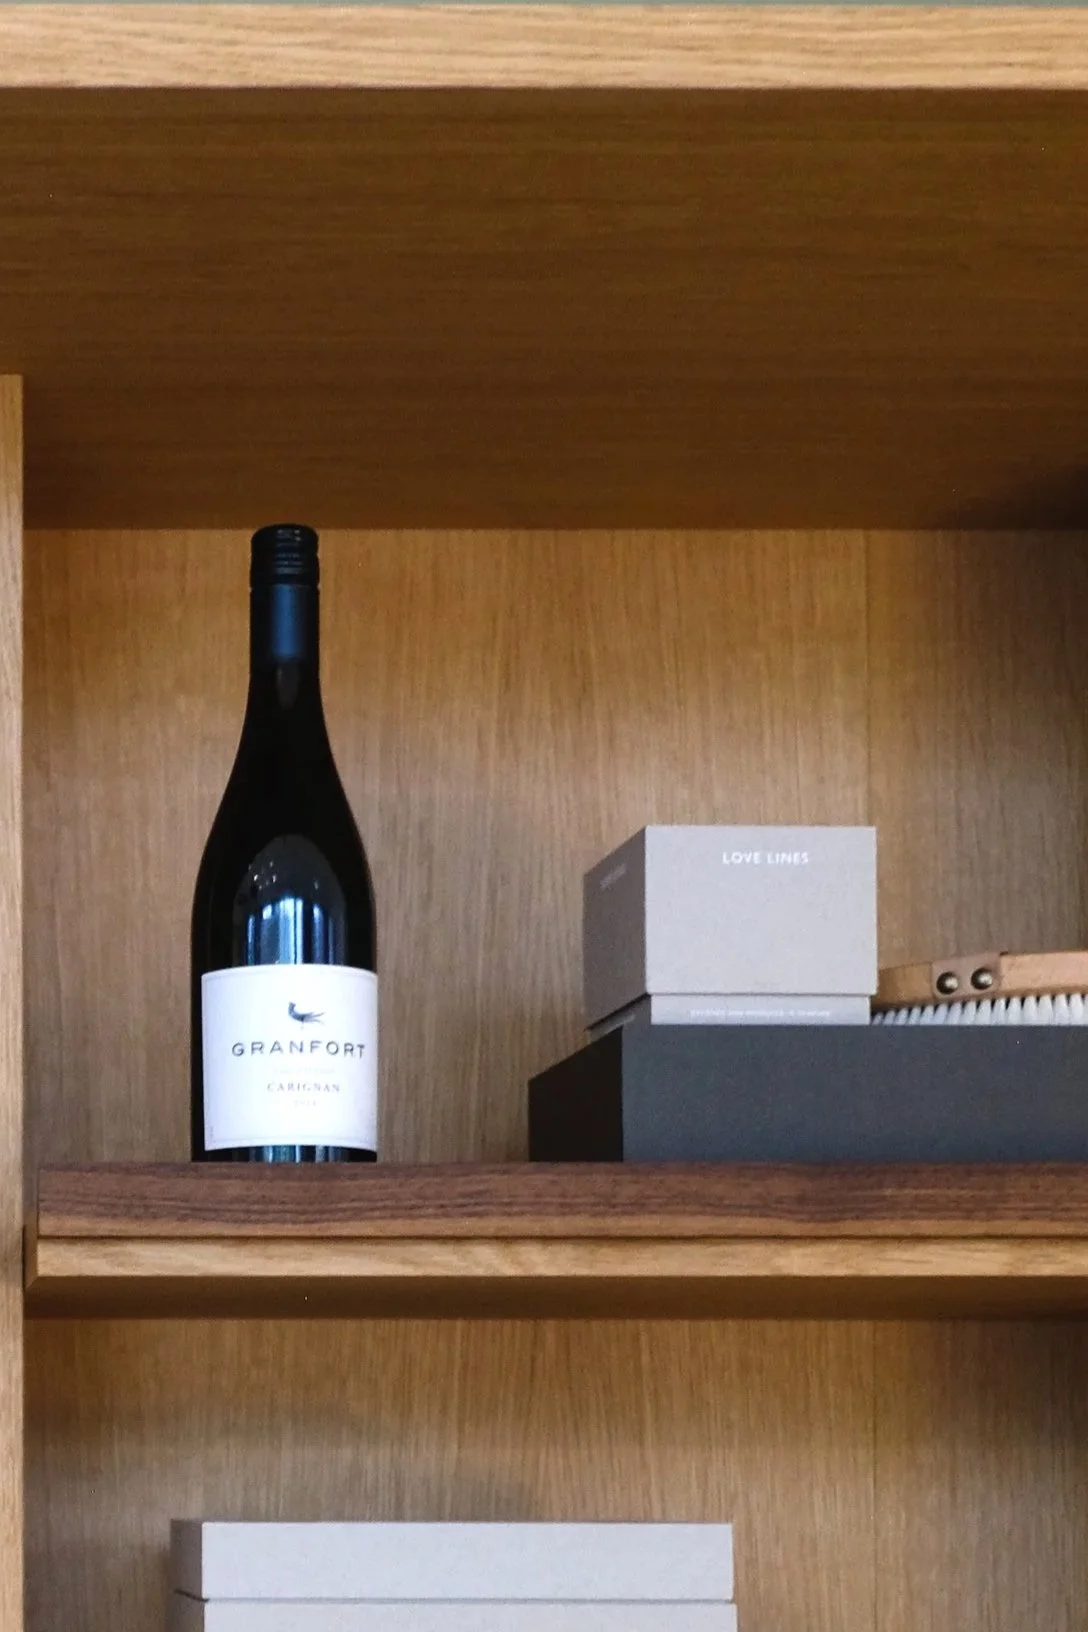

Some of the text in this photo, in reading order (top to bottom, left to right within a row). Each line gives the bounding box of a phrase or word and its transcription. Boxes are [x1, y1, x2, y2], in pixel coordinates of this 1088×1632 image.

[722, 852, 809, 865] LOVE LINES
[231, 1040, 366, 1059] GRANFORT
[267, 1082, 340, 1093] CARIGNAN
